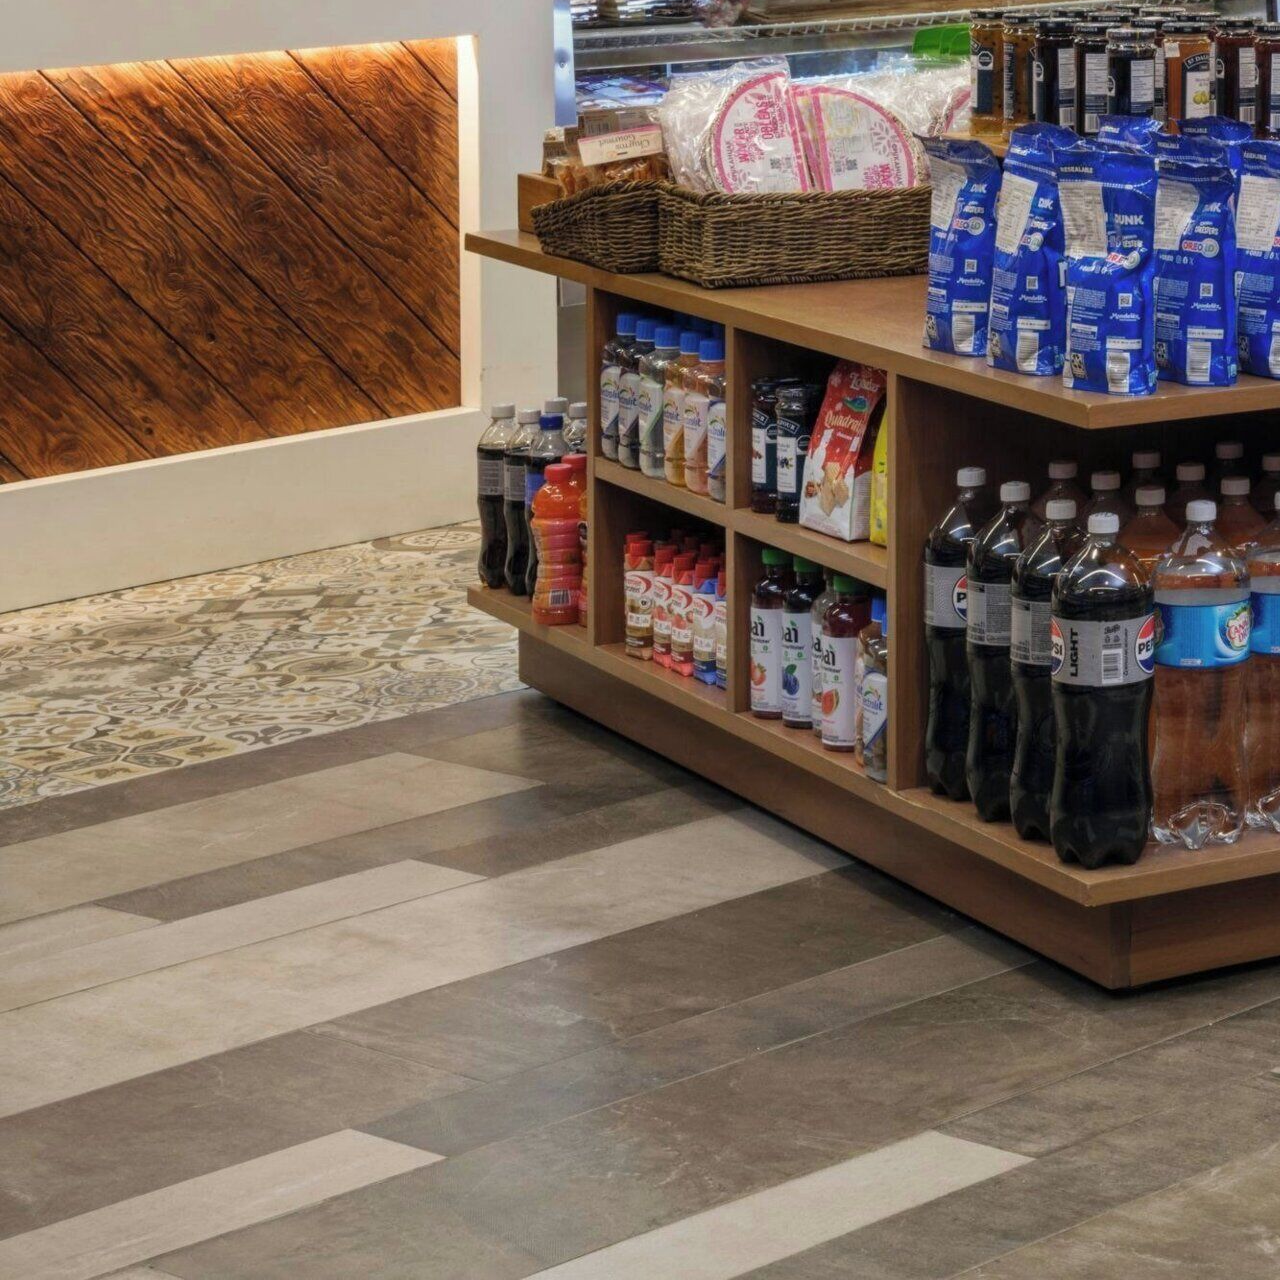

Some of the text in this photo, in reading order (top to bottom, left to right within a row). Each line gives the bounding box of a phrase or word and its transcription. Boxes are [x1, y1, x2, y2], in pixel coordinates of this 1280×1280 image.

[1114, 214, 1144, 225] DUNK
[1184, 242, 1202, 252] OREO
[1070, 628, 1080, 677] LIGHT
